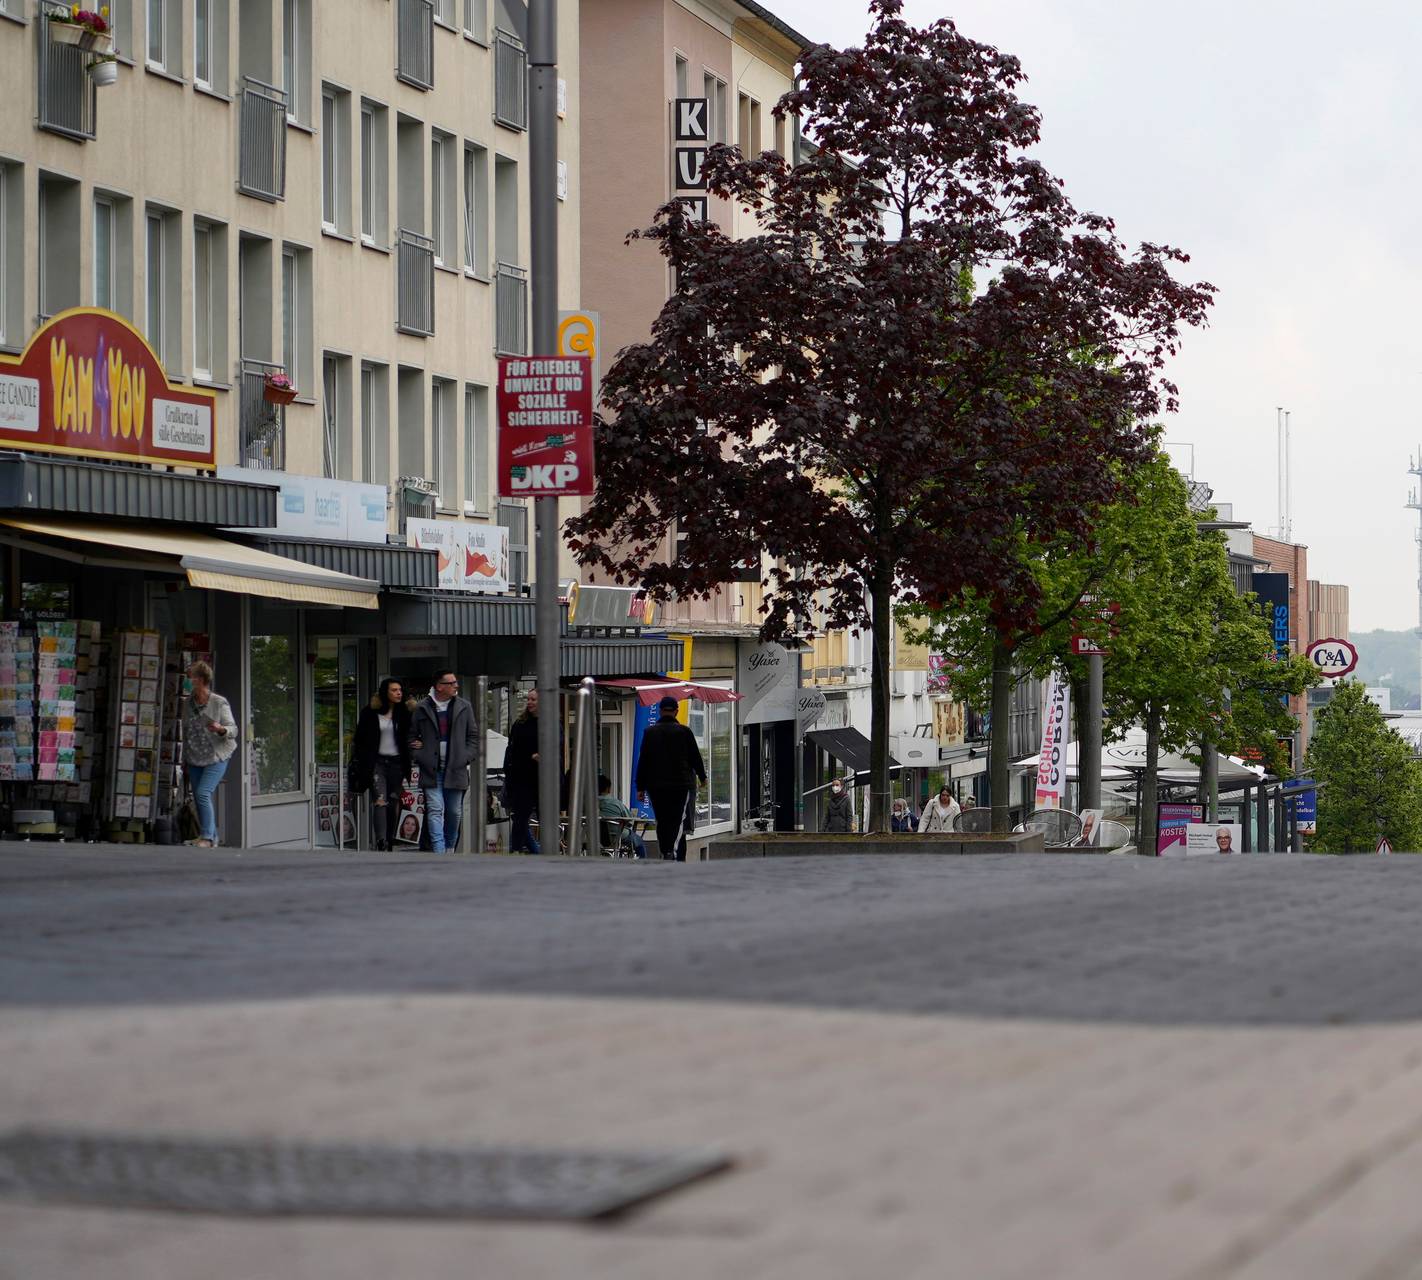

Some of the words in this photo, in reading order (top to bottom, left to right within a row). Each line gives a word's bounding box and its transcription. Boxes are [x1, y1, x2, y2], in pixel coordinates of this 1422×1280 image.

[507, 360, 528, 376] FÜR
[529, 360, 583, 376] FRIEDEN,
[504, 377, 552, 393] UMWELT
[556, 377, 582, 392] UND
[108, 347, 146, 440] YOU
[518, 394, 567, 409] SOZIALE
[508, 411, 583, 426] SICHERHEIT:
[511, 464, 579, 489] DKP
[1314, 649, 1348, 667] C&A
